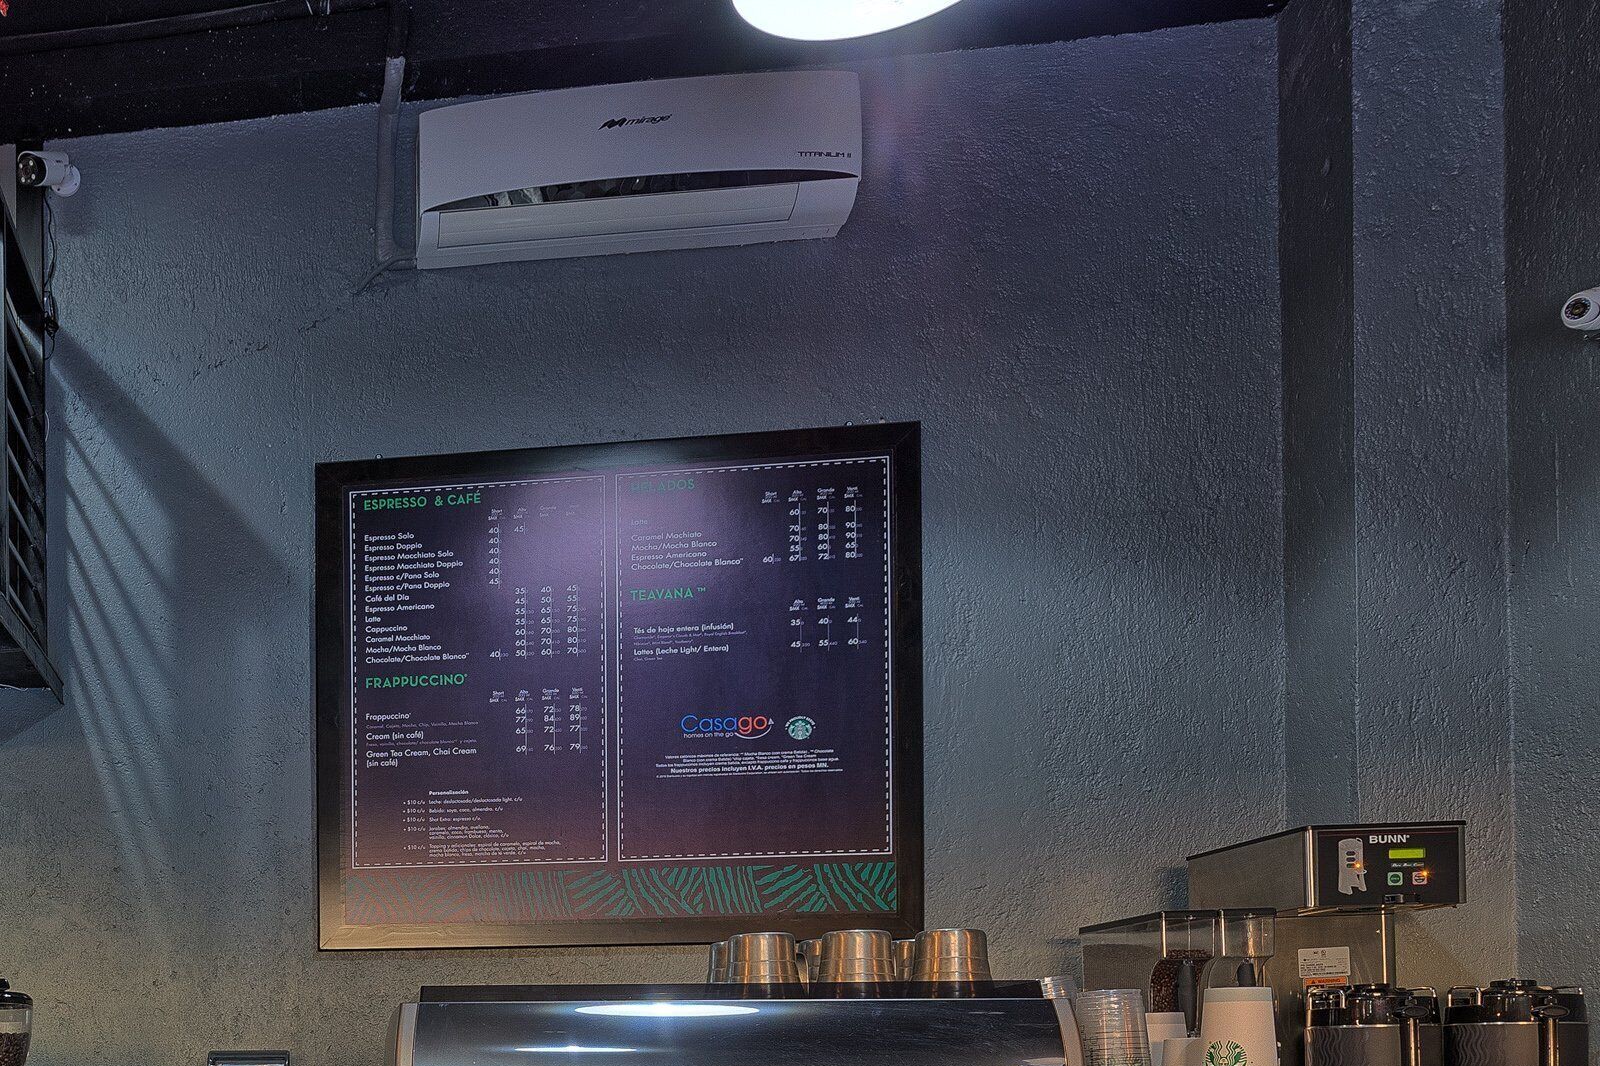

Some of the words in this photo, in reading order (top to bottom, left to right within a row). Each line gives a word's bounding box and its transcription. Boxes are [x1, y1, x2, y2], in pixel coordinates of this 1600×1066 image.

[625, 114, 672, 125] mirage
[364, 497, 427, 510] ESPRESSO
[435, 496, 443, 506] &
[448, 491, 480, 505] CAFÉ
[365, 534, 395, 542] Espresso
[365, 544, 395, 552] Espresso
[397, 542, 422, 550] Doppio
[692, 540, 717, 548] Blanco
[632, 553, 663, 561] Espresso
[666, 551, 707, 559] Americano
[438, 560, 463, 569] Doppio
[424, 581, 450, 589] Doppio
[631, 587, 693, 601] TEAVANA
[365, 615, 380, 623] Latte
[365, 625, 407, 633] Cappuccino
[659, 625, 674, 634] hoja
[676, 624, 699, 632] entera
[366, 635, 393, 643] Caramel
[366, 644, 415, 654] Mocha/Mocha
[418, 643, 441, 651] Blanco
[634, 648, 654, 656] Lattes
[656, 647, 678, 656] (Leche
[704, 644, 728, 653] Entera)
[366, 653, 441, 664] Chocolate/Chocolate
[681, 715, 767, 734] Casago
[392, 732, 404, 740] (sin
[406, 730, 423, 739] café)
[367, 750, 388, 758] Green
[405, 749, 430, 757] Cream,
[433, 747, 450, 755] Chai
[453, 747, 476, 755] Cream
[367, 759, 378, 768] (sin
[380, 758, 398, 767] café)
[1369, 835, 1407, 844] BUNN
